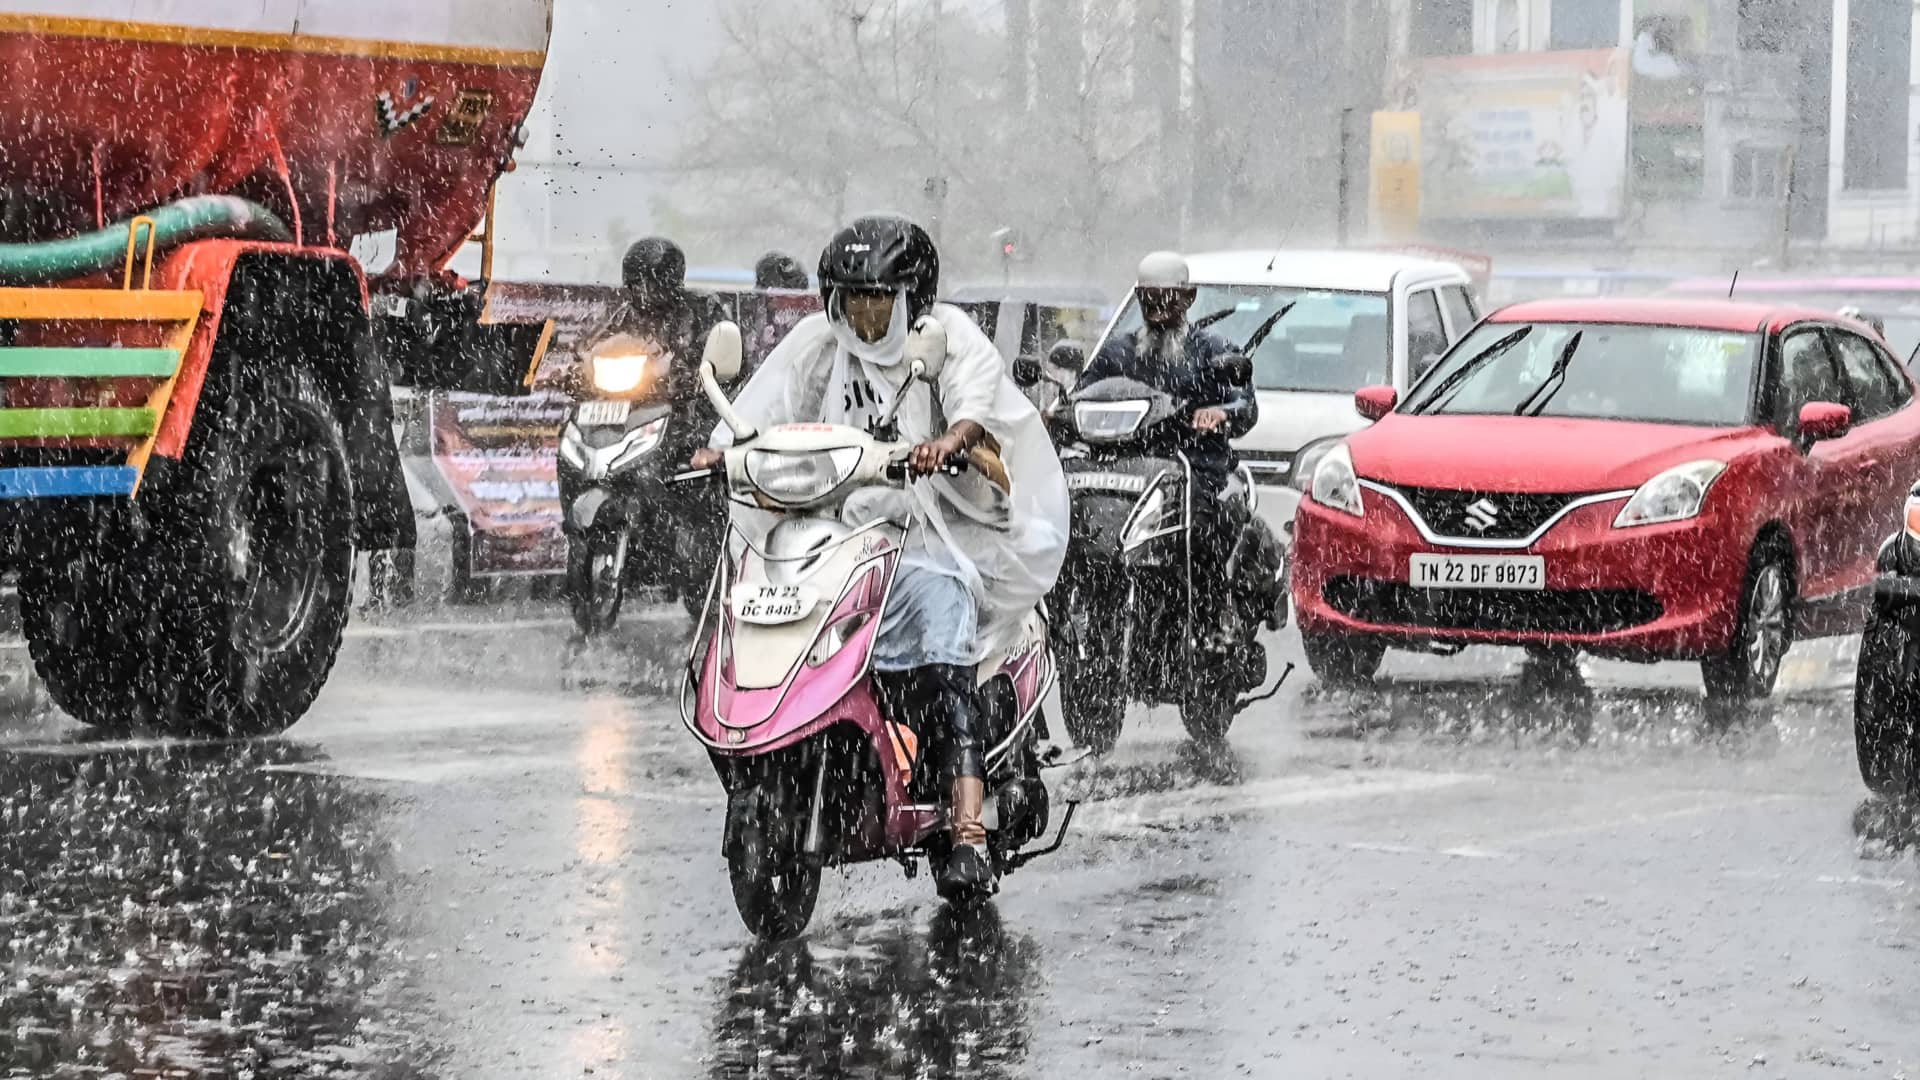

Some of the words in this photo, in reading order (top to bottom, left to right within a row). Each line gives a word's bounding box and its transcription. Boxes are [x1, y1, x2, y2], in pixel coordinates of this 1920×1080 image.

[1420, 562, 1439, 582] TN
[1445, 562, 1464, 582] 22
[1471, 563, 1490, 583] DF
[759, 585, 778, 598] TN
[782, 585, 800, 598] 22
